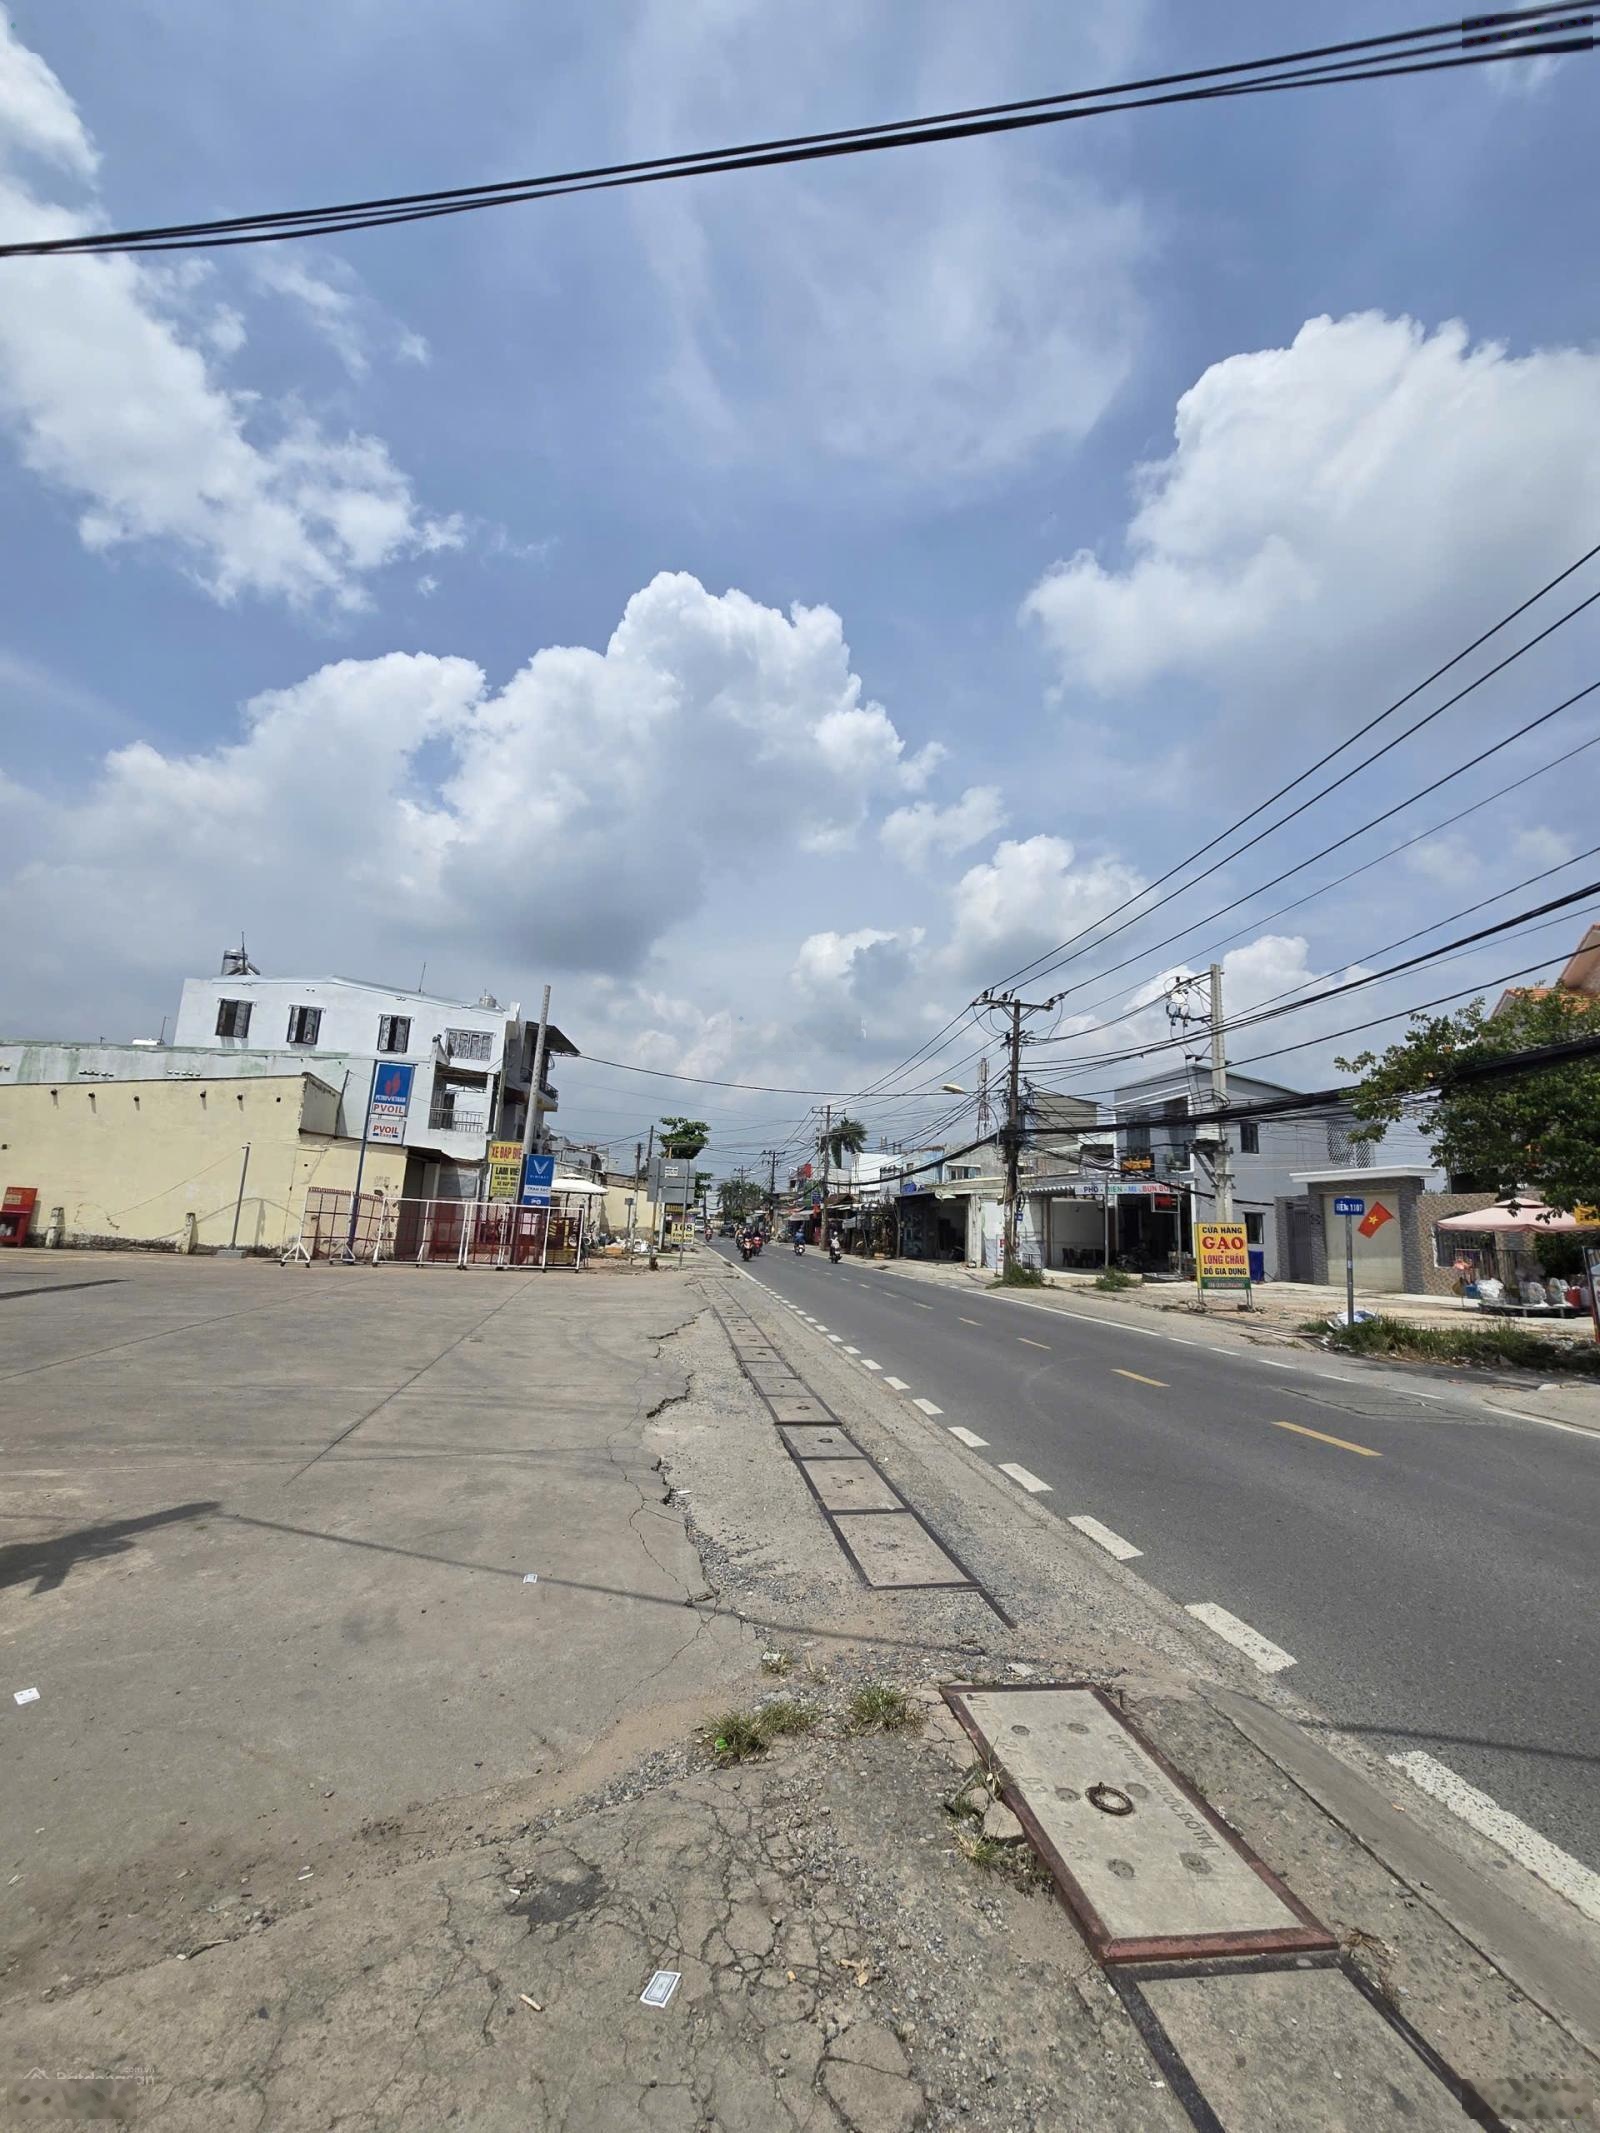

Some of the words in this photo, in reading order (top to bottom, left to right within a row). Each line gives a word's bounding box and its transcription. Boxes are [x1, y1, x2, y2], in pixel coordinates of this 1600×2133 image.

[373, 1104, 403, 1114] PVOIL
[373, 1124, 399, 1134] PVOIL
[491, 1146, 500, 1158] XE
[1202, 1236, 1244, 1253] GẠO
[1204, 1255, 1224, 1264] LONG
